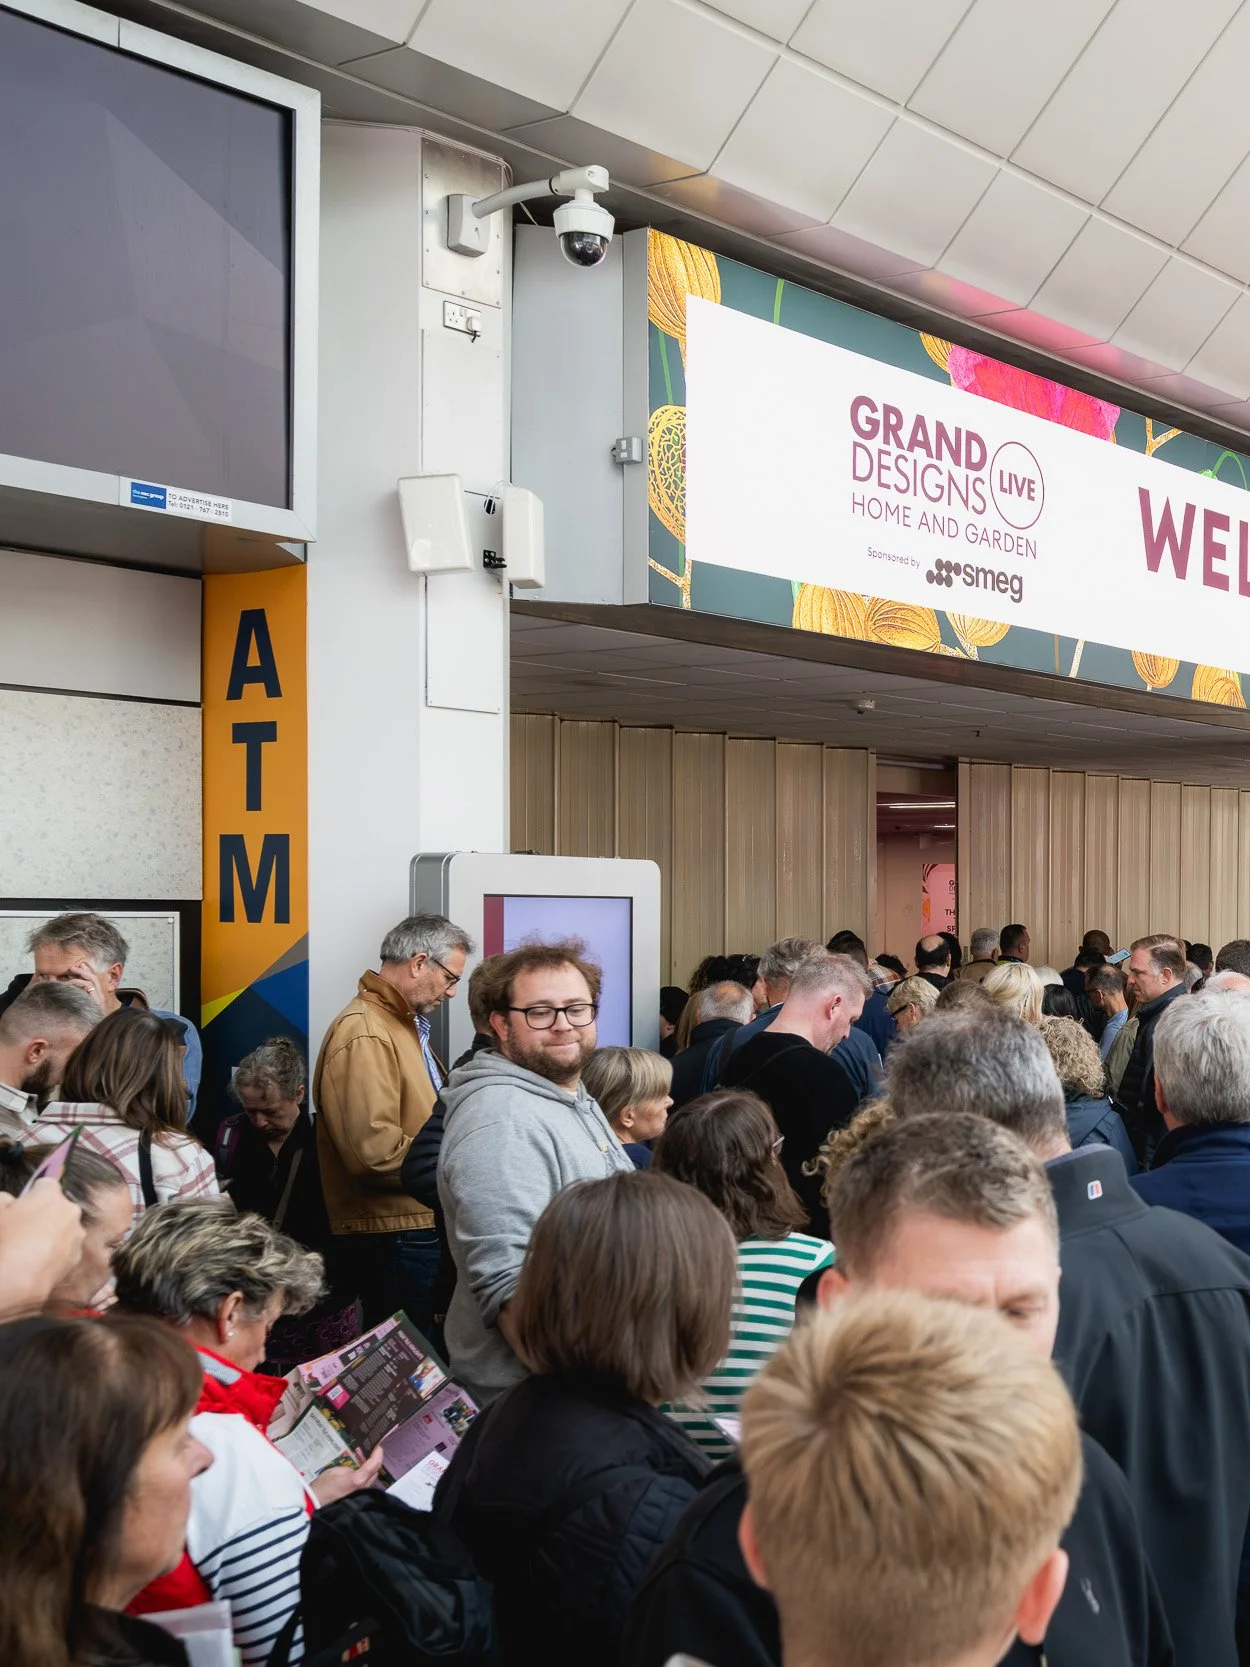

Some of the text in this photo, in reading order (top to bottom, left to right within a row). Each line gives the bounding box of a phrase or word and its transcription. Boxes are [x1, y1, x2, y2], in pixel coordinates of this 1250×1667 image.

[850, 395, 988, 472] GRAND
[179, 496, 212, 507] ADVERTISE
[852, 441, 987, 515] DESIGNS
[999, 469, 1036, 502] LIVE
[852, 492, 1037, 559] HOME AND GARDEN
[867, 547, 921, 569] Sponsored by
[962, 563, 1023, 603] smeg
[219, 608, 290, 924] ATM
